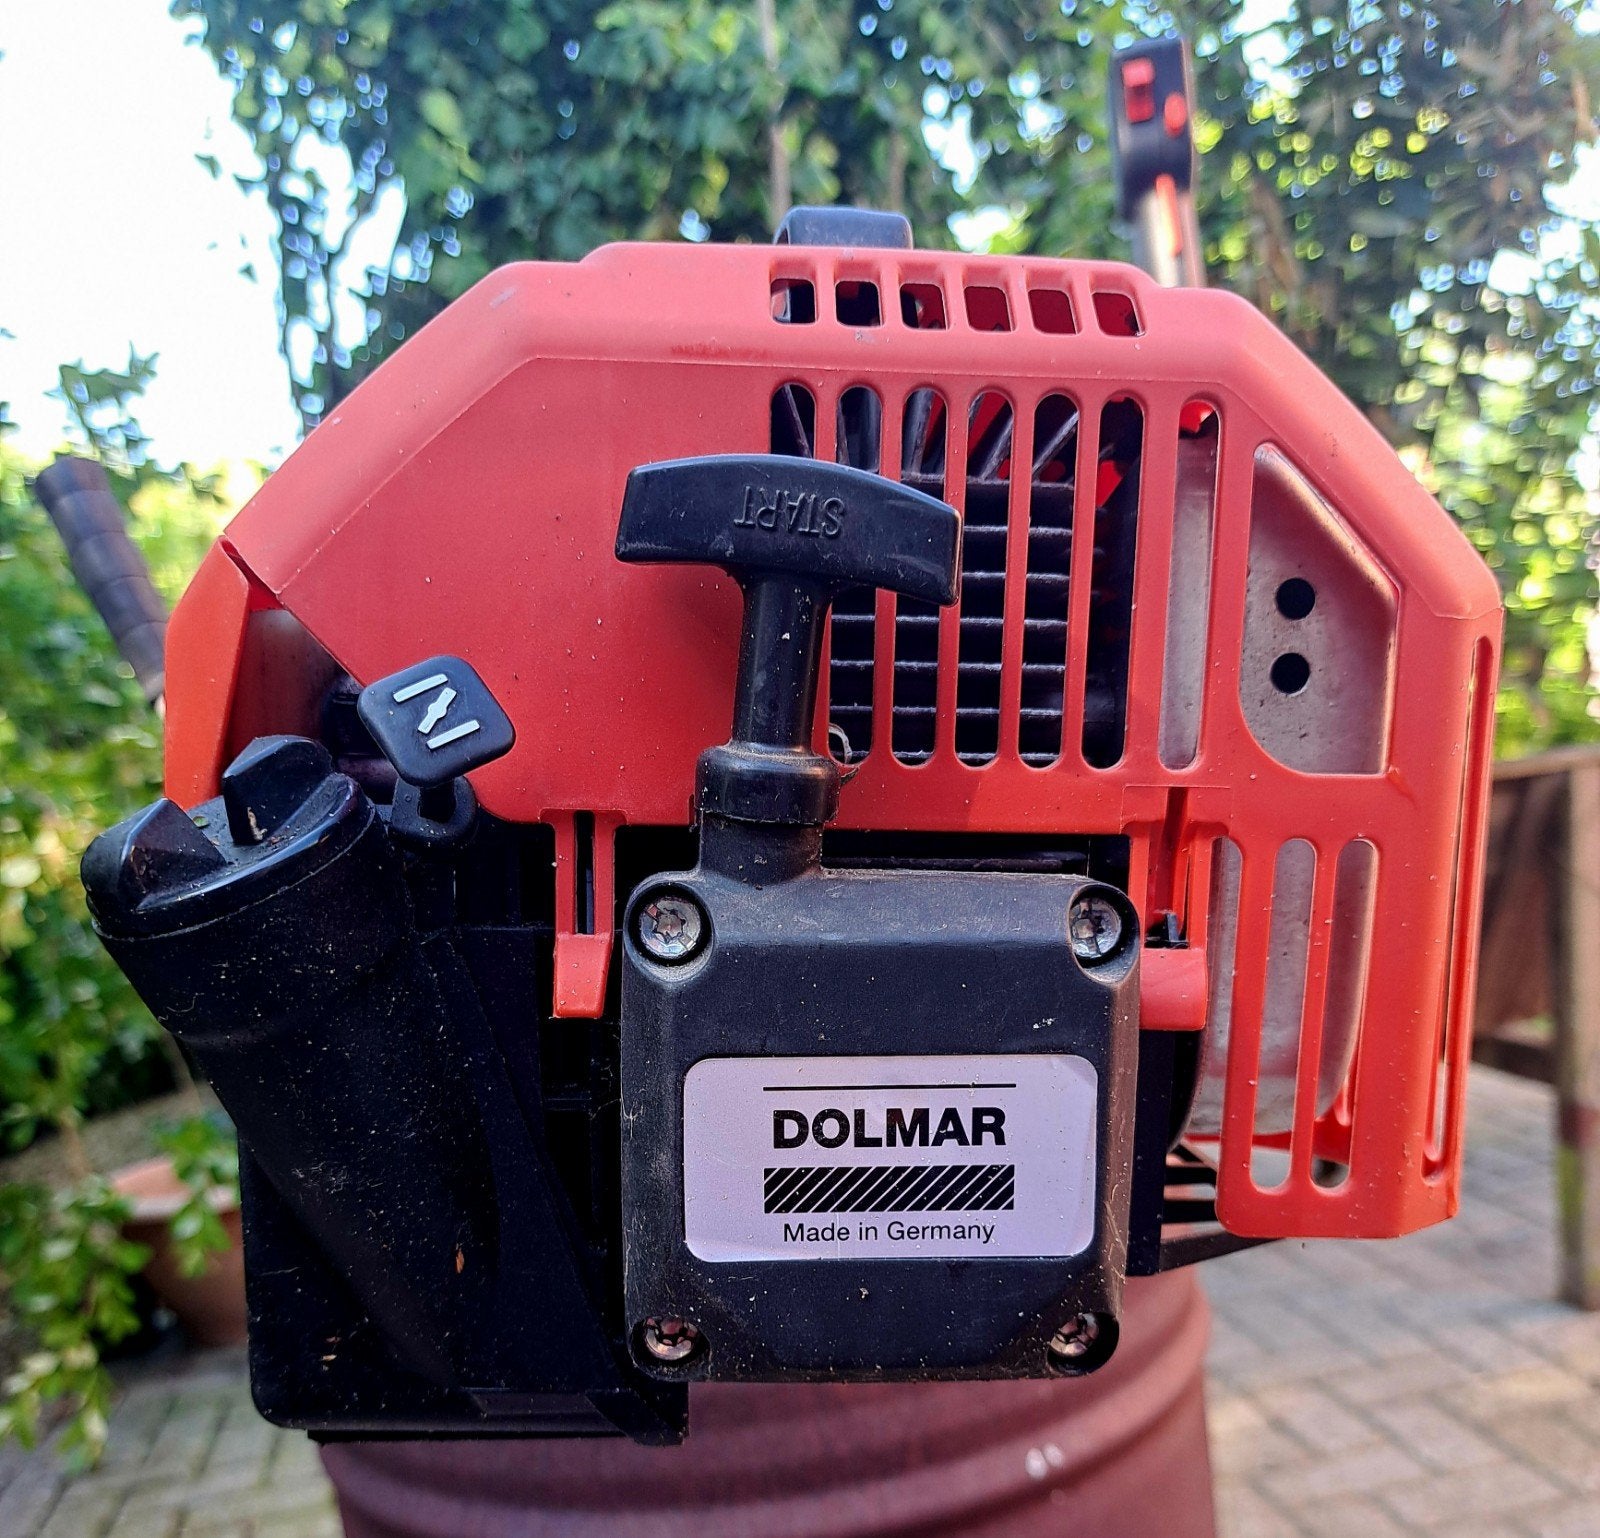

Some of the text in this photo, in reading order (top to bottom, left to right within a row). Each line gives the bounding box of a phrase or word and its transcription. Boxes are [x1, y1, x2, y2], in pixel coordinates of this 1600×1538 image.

[733, 485, 845, 538] START
[773, 1107, 1006, 1149] DOLMAR
[783, 1221, 995, 1244] Made in Germany
